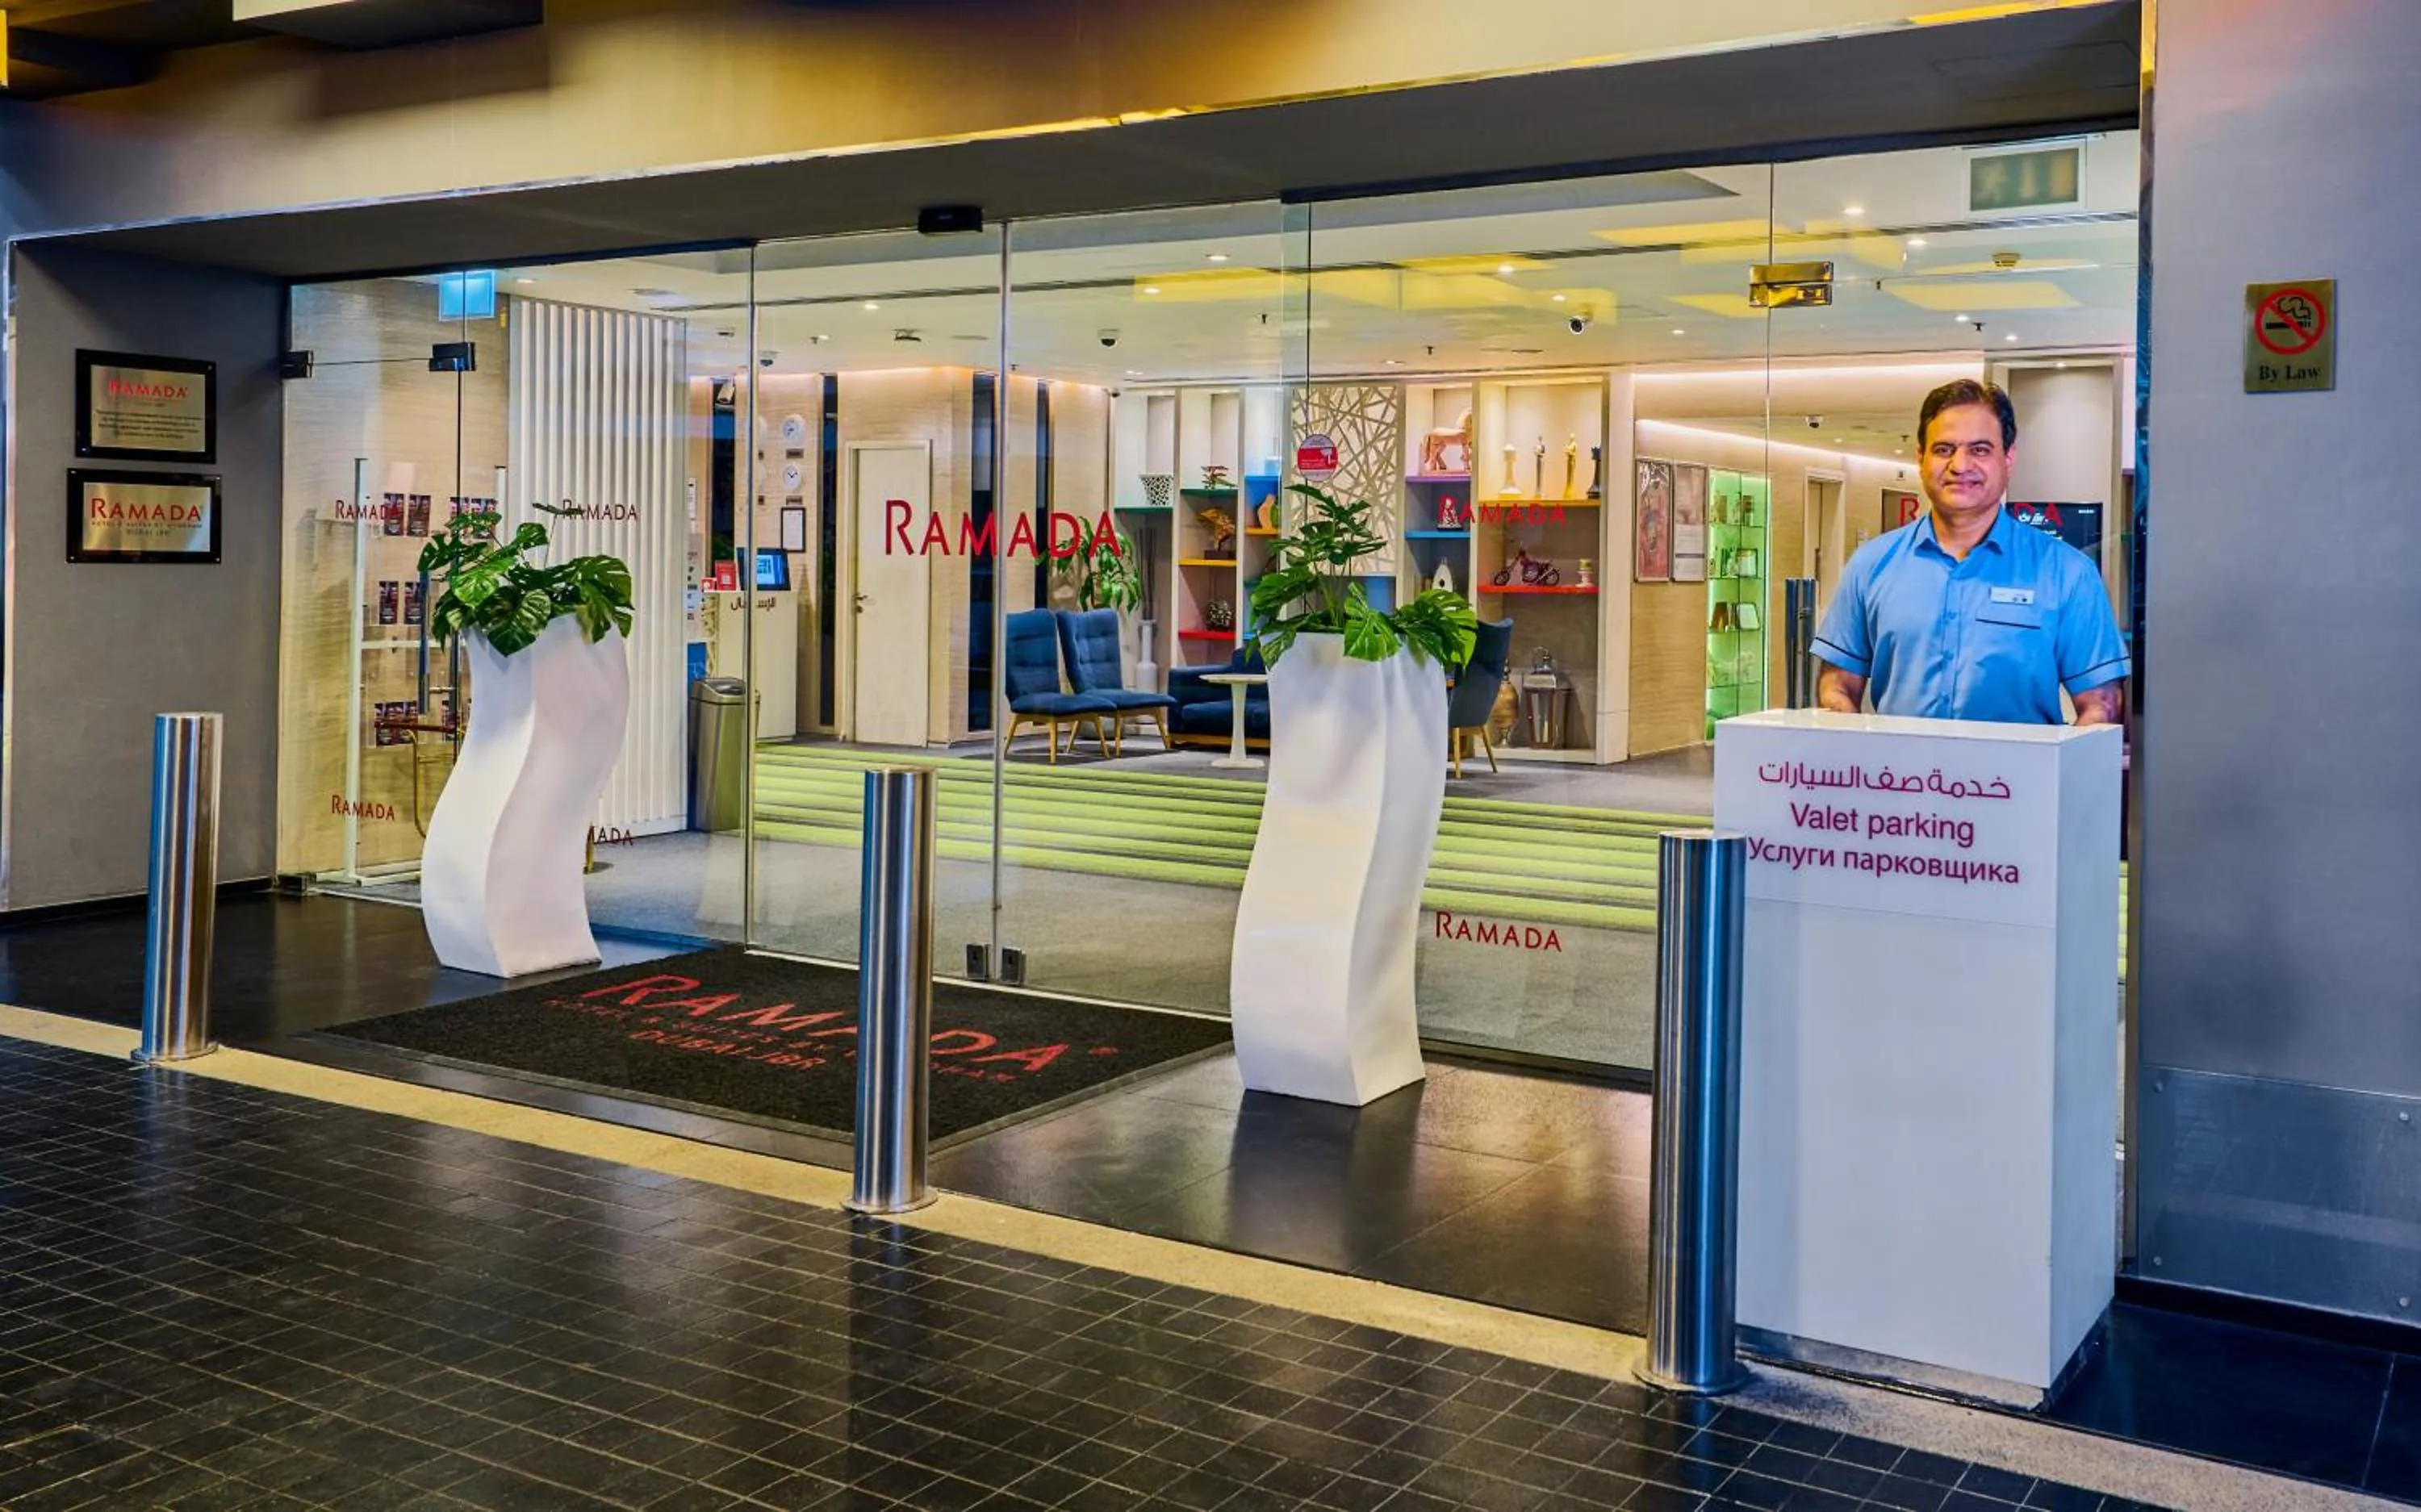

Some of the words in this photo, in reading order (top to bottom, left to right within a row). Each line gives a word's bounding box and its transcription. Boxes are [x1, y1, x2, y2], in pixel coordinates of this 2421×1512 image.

[2259, 365, 2278, 382] By
[2285, 365, 2320, 380] Law
[90, 498, 201, 521] RAMADA
[335, 499, 400, 520] RAMADA
[1438, 492, 1567, 526] RAMADA
[884, 499, 1123, 558] RAMADA
[1758, 761, 1860, 792] السيارات
[1863, 766, 1924, 793] صف
[1927, 767, 2010, 800] خدمة
[332, 795, 395, 821] RAMADA
[1790, 802, 1858, 833] Valet
[1867, 812, 1975, 849] parking
[1748, 836, 1835, 870] Услуги
[1843, 850, 2020, 884] парковщика
[1435, 911, 1562, 953] RAMADA
[581, 973, 1071, 1072] RAMDA
